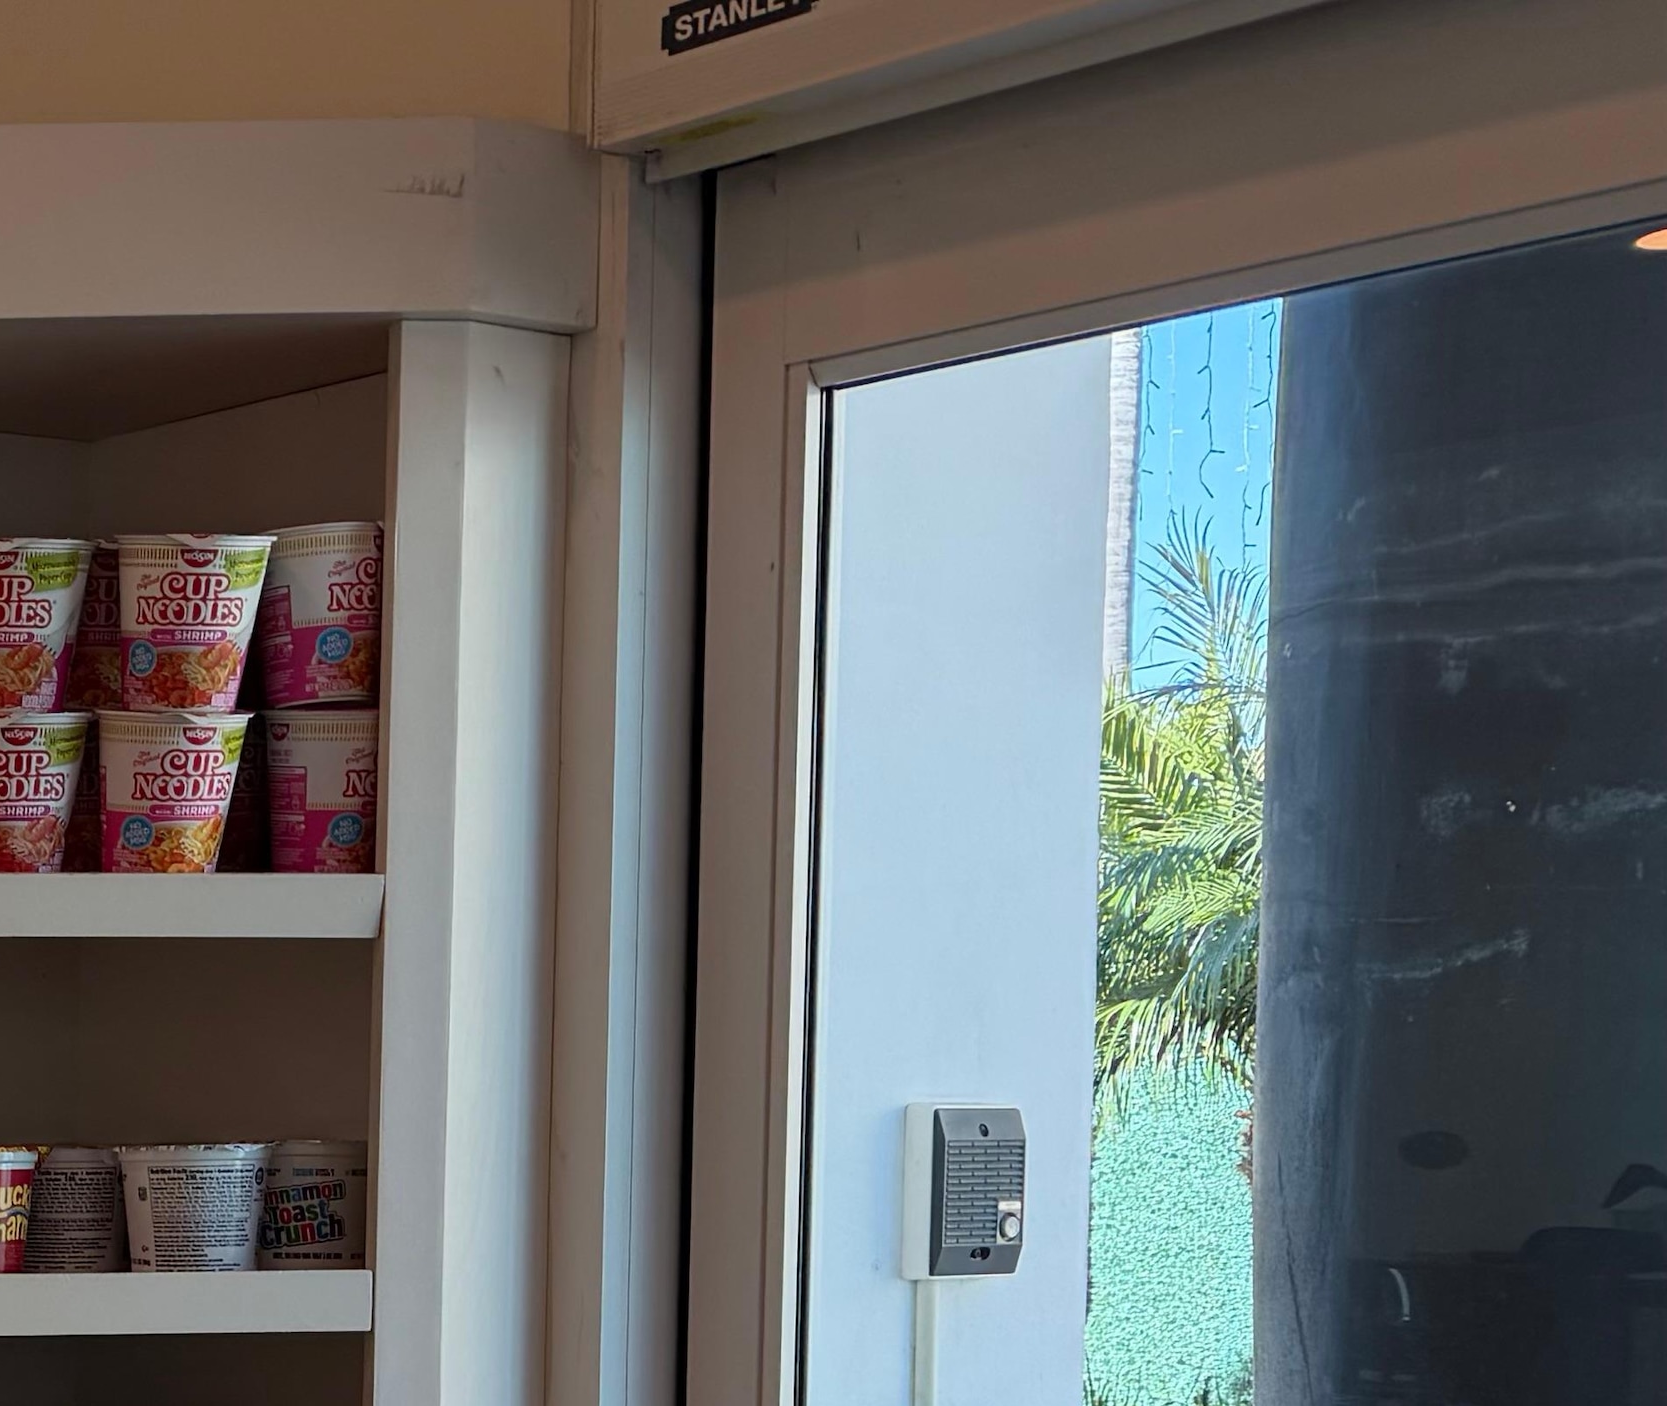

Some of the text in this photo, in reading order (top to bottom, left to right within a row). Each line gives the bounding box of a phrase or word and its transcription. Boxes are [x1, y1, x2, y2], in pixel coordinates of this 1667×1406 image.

[674, 0, 800, 40] STANL
[162, 573, 230, 599] CUP
[137, 598, 243, 626] NOODLES
[175, 630, 221, 640] SHRIMP
[162, 750, 224, 775] CUP
[133, 774, 231, 801] NOODLES
[0, 806, 45, 815] SHRIMP
[174, 806, 215, 815] SHRIMP
[265, 1182, 344, 1206] nnamon
[266, 1199, 329, 1226] Toast
[260, 1213, 344, 1247] Crunch
